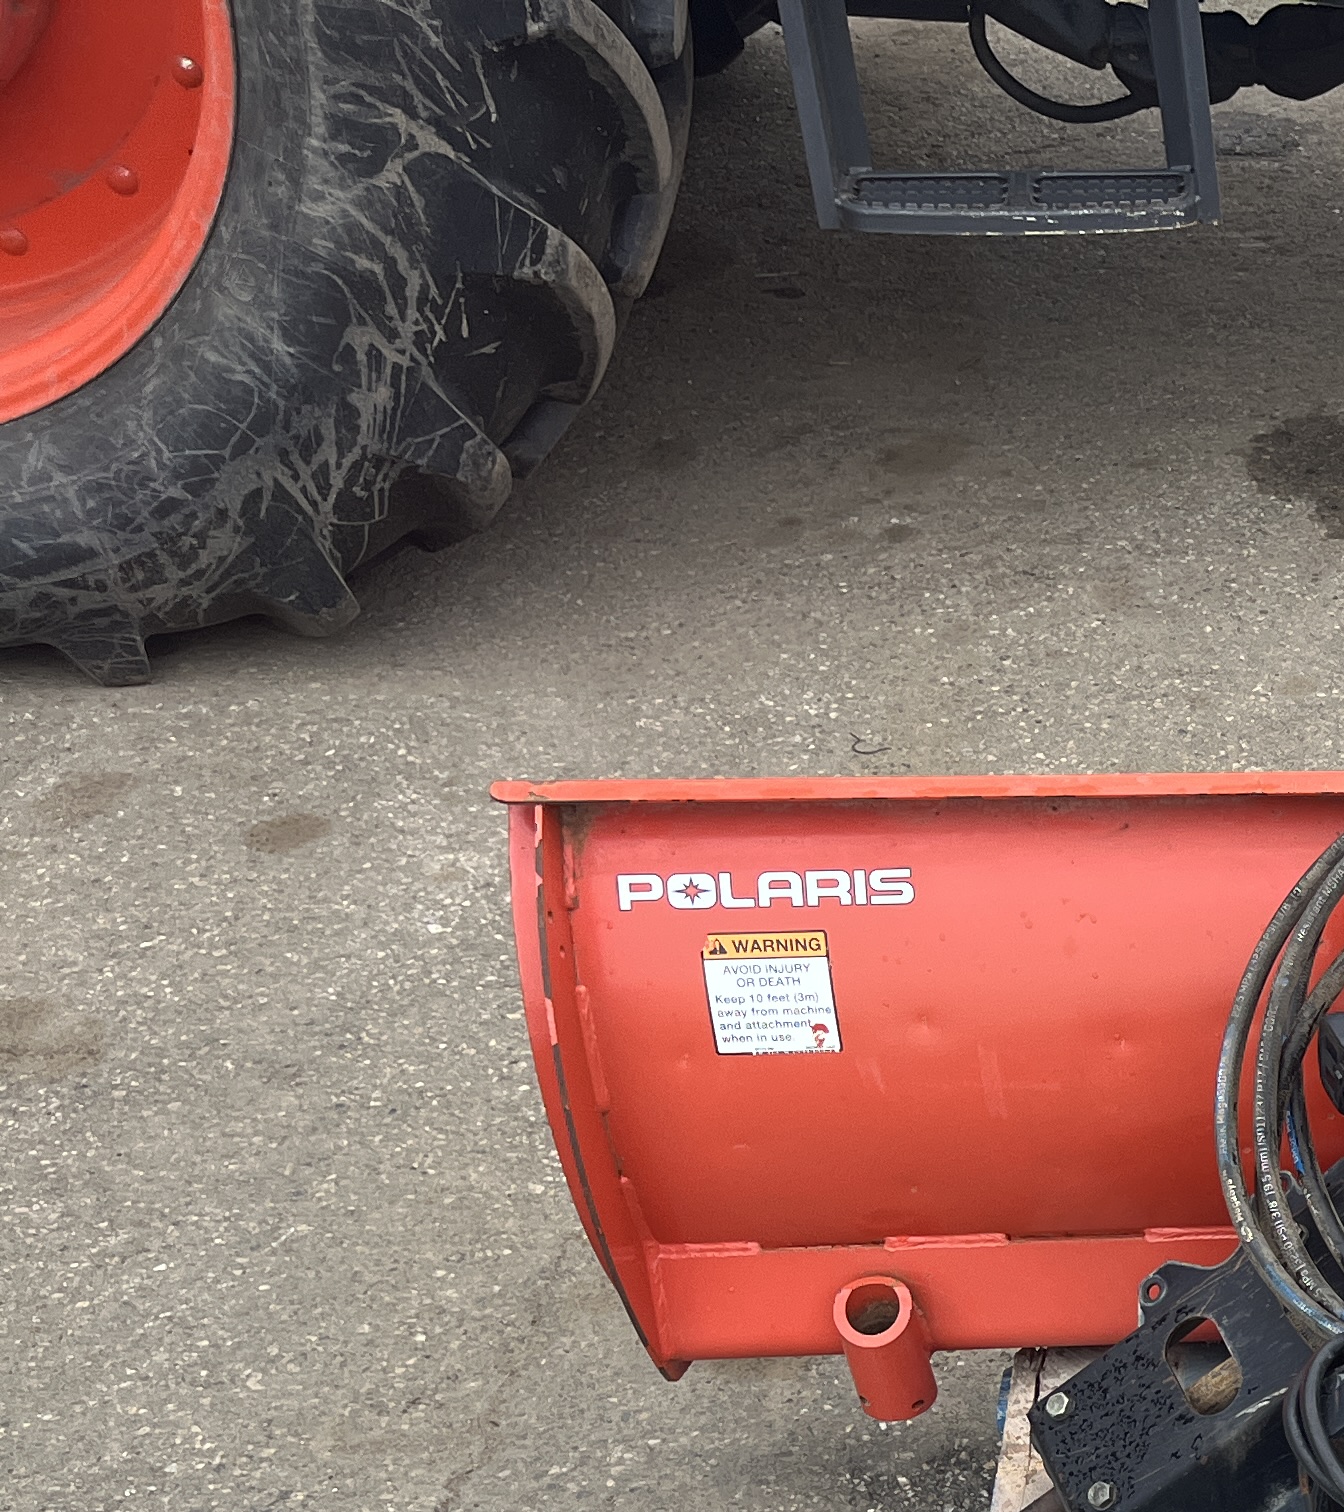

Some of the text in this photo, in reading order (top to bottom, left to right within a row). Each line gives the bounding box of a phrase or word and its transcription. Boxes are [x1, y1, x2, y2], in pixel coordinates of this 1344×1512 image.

[616, 867, 916, 912] POLARIS
[731, 937, 822, 954] WARNING
[723, 963, 810, 975] AVOID INJURY
[736, 976, 801, 988] OR DEATH
[715, 992, 819, 1005] Keep 10 feet (3m)
[717, 1005, 832, 1019] away from machine
[719, 1019, 811, 1030] and attachment
[721, 1034, 753, 1043] when
[756, 1033, 767, 1042] in
